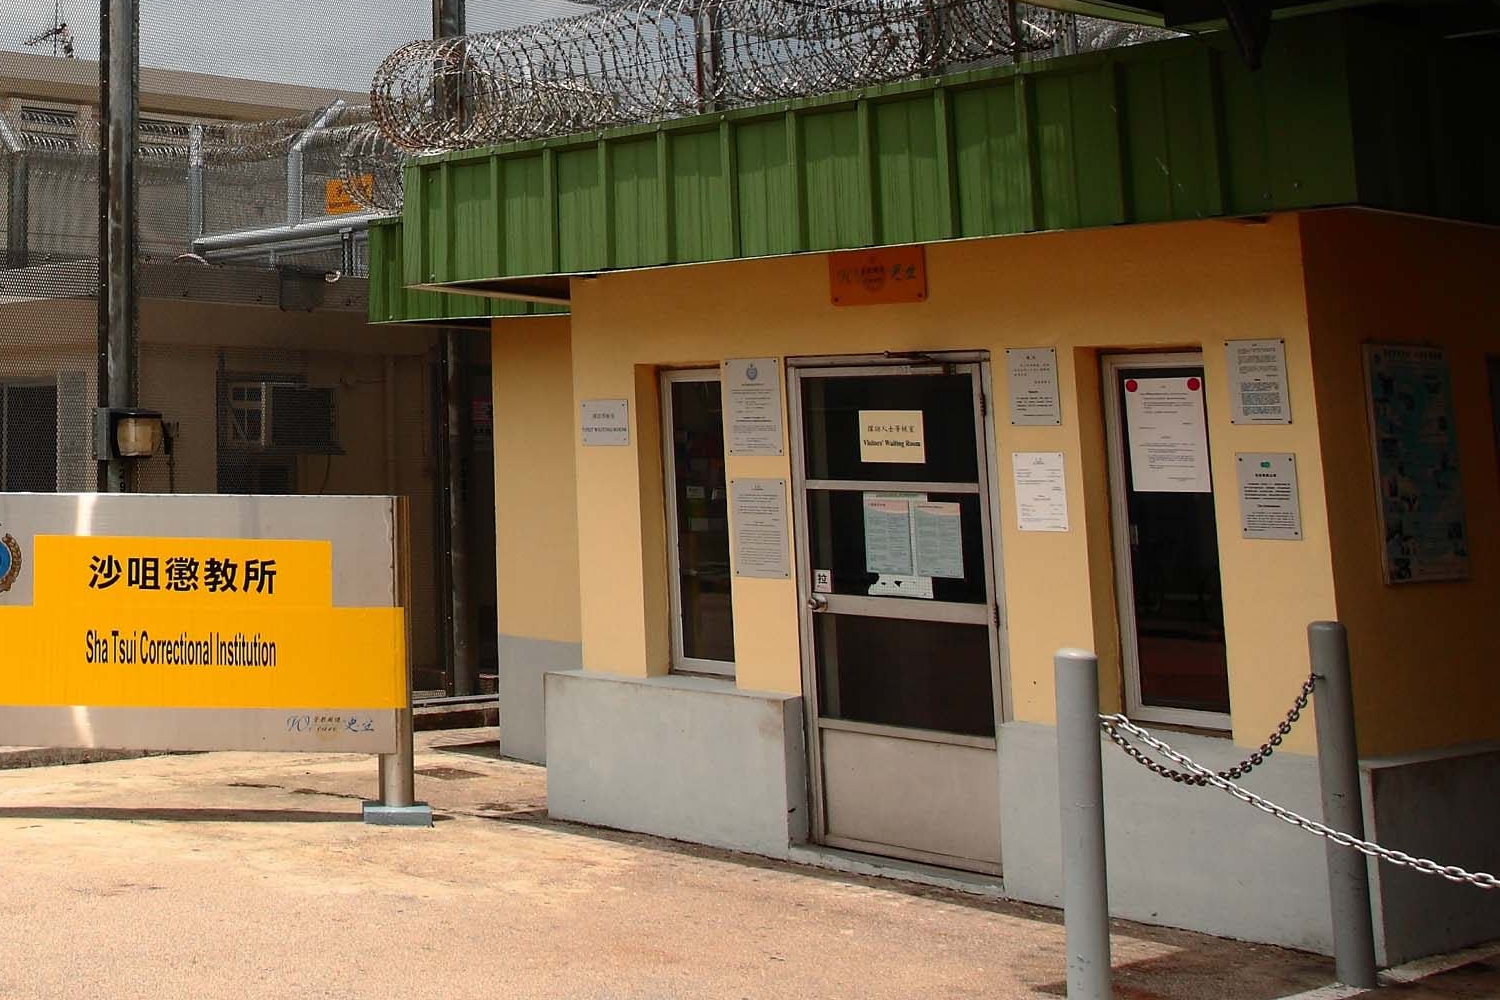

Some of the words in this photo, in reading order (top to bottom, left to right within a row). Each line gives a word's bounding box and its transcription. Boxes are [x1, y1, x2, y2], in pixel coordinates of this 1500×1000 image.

[88, 554, 277, 595] 沙咀懲教所
[817, 572, 828, 585] 拉
[85, 629, 109, 664] Sha
[111, 629, 137, 665] Tsui
[140, 630, 213, 666] Correctional
[216, 631, 276, 667] Institution
